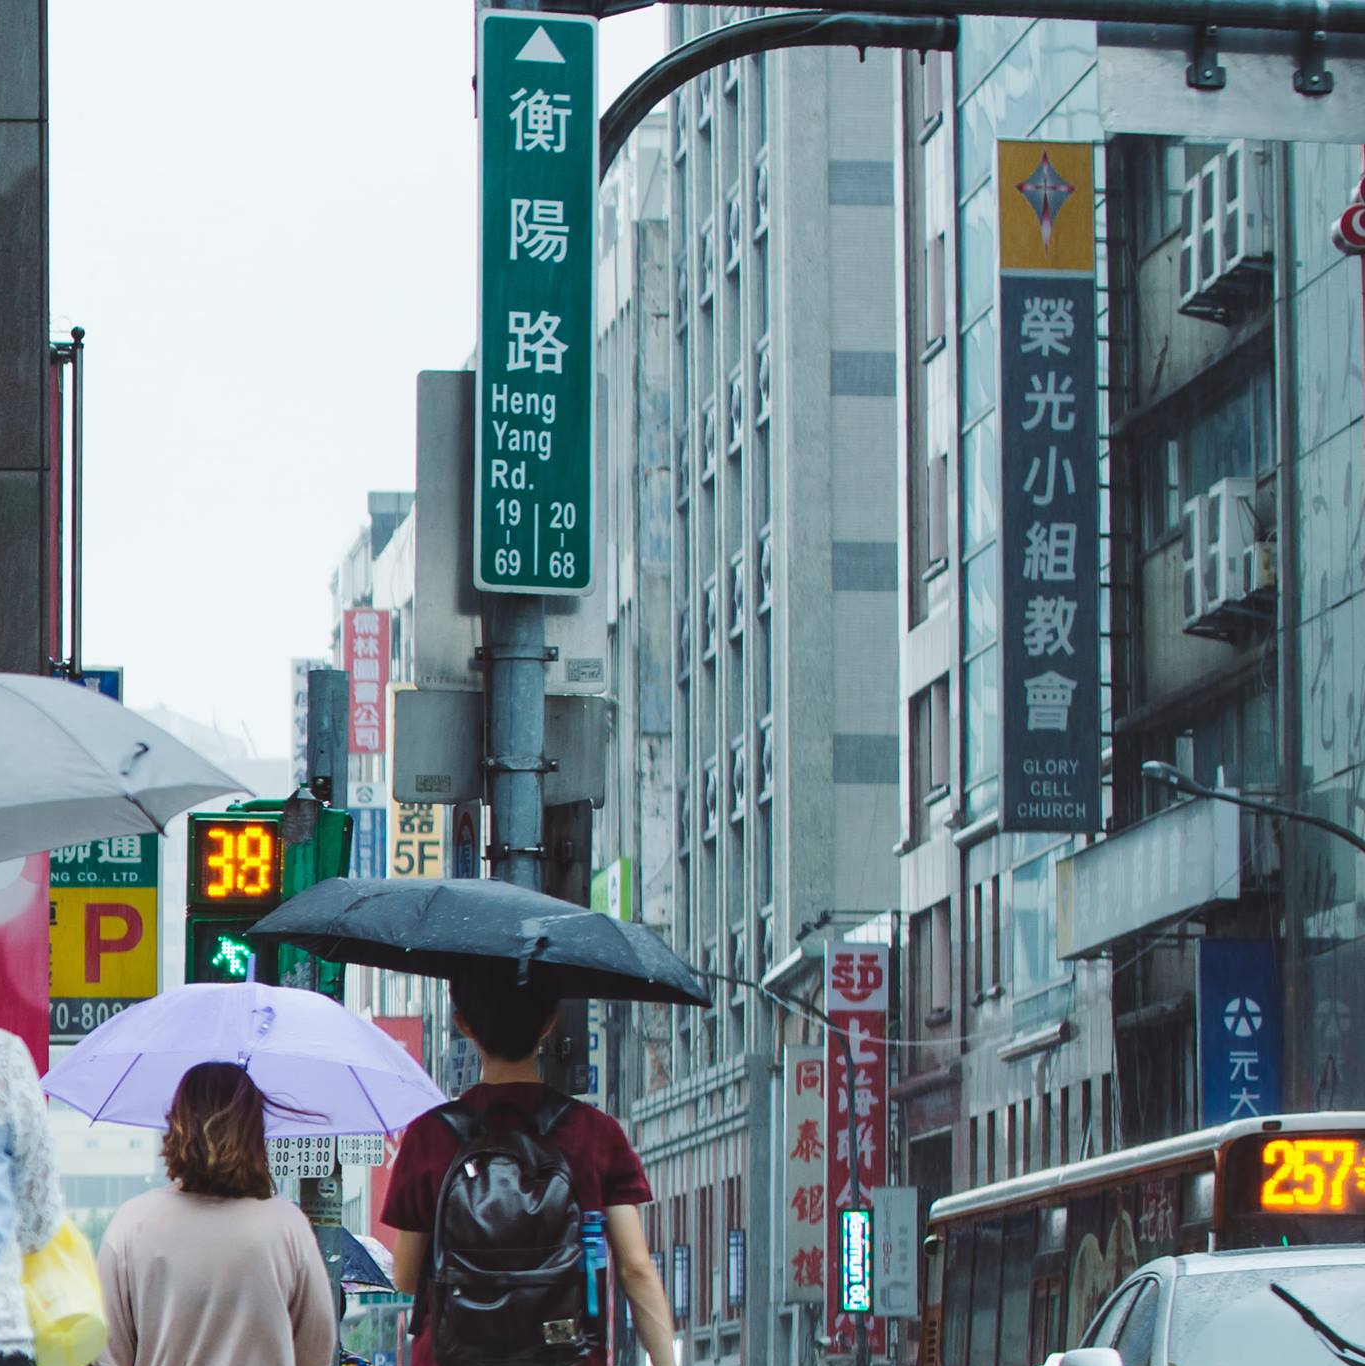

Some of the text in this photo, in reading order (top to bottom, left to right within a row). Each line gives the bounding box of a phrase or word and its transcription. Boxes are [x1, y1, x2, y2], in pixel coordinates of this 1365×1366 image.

[508, 87, 572, 374] 衡陽路
[491, 383, 556, 424] Heng
[492, 420, 552, 461] Yang
[491, 459, 535, 491] Rd.
[1020, 297, 1078, 732] 榮光小組教會
[1022, 759, 1078, 775] GLORY
[1030, 780, 1072, 797] CELL
[1017, 802, 1086, 818] CHURCH
[112, 872, 142, 882] LTD.
[394, 840, 440, 875] 5F
[84, 902, 144, 984] P
[1229, 1051, 1261, 1118] 元大
[1262, 1140, 1356, 1206] 257
